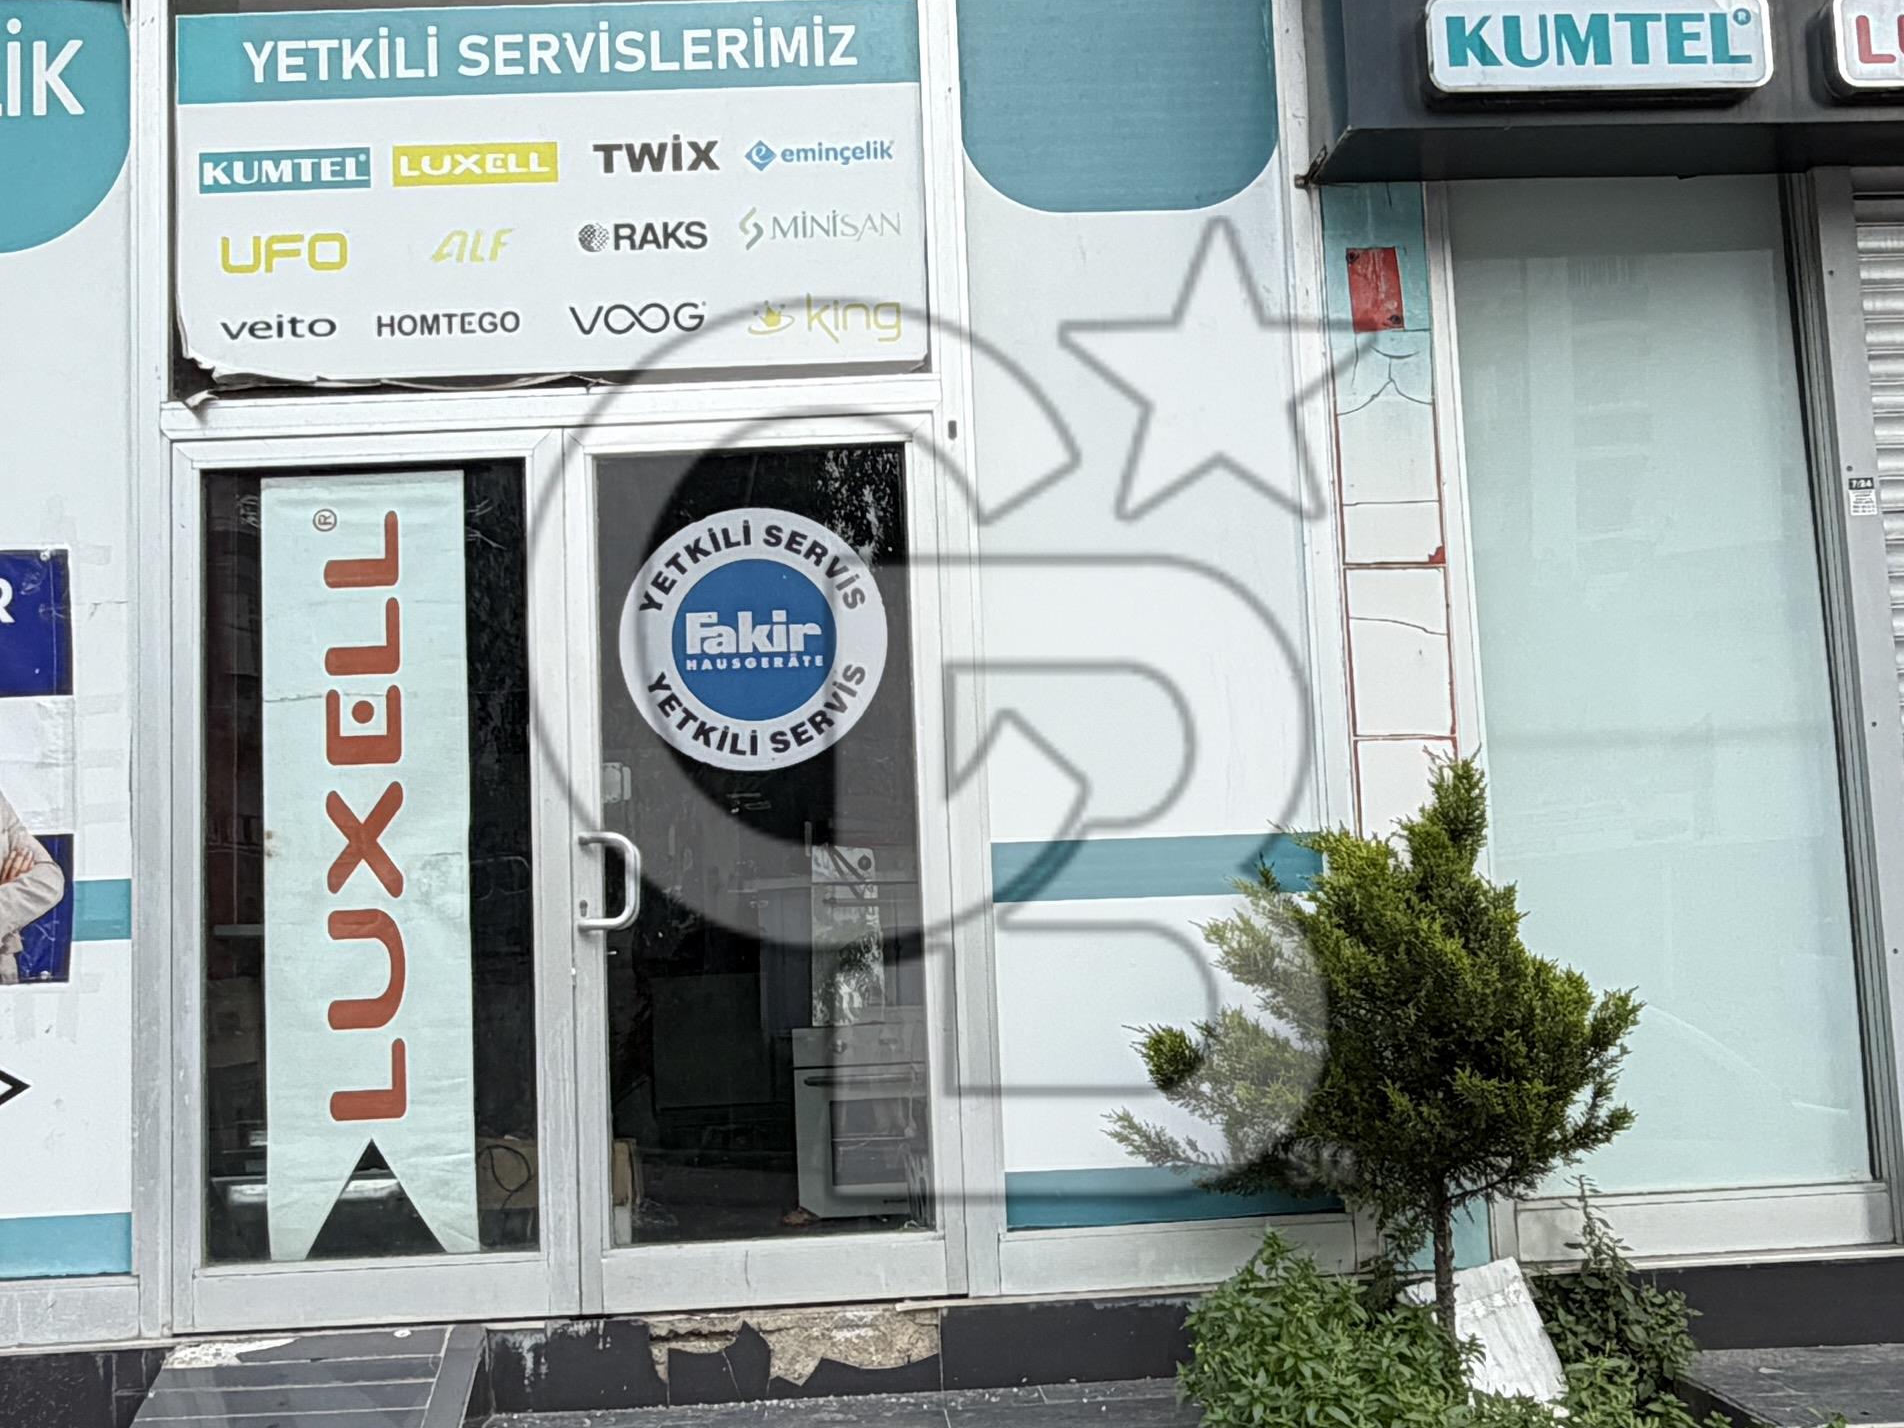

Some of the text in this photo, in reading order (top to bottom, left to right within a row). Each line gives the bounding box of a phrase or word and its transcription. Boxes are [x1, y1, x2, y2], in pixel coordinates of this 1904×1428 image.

[243, 15, 859, 83] YETKİLİ SERVİSLERİMİZ
[1445, 11, 1752, 69] KUMTEL
[203, 155, 369, 186] KUMTEL
[399, 151, 551, 177] LUXELL
[781, 140, 893, 165] eminçelik
[221, 232, 349, 274] UFO
[431, 227, 514, 264] ALF
[613, 221, 708, 251] RAKS
[221, 314, 337, 340] veito
[376, 311, 521, 337] HOMTEGO
[568, 301, 705, 335] VOOG
[806, 293, 902, 343] king
[639, 519, 866, 613] YETKİLİ SERVİS
[686, 610, 822, 655] Fakir
[686, 652, 824, 671] HAUSGERÄTE
[647, 663, 866, 756] YETKİLİ SERVİS
[322, 509, 408, 1122] LUXELL
